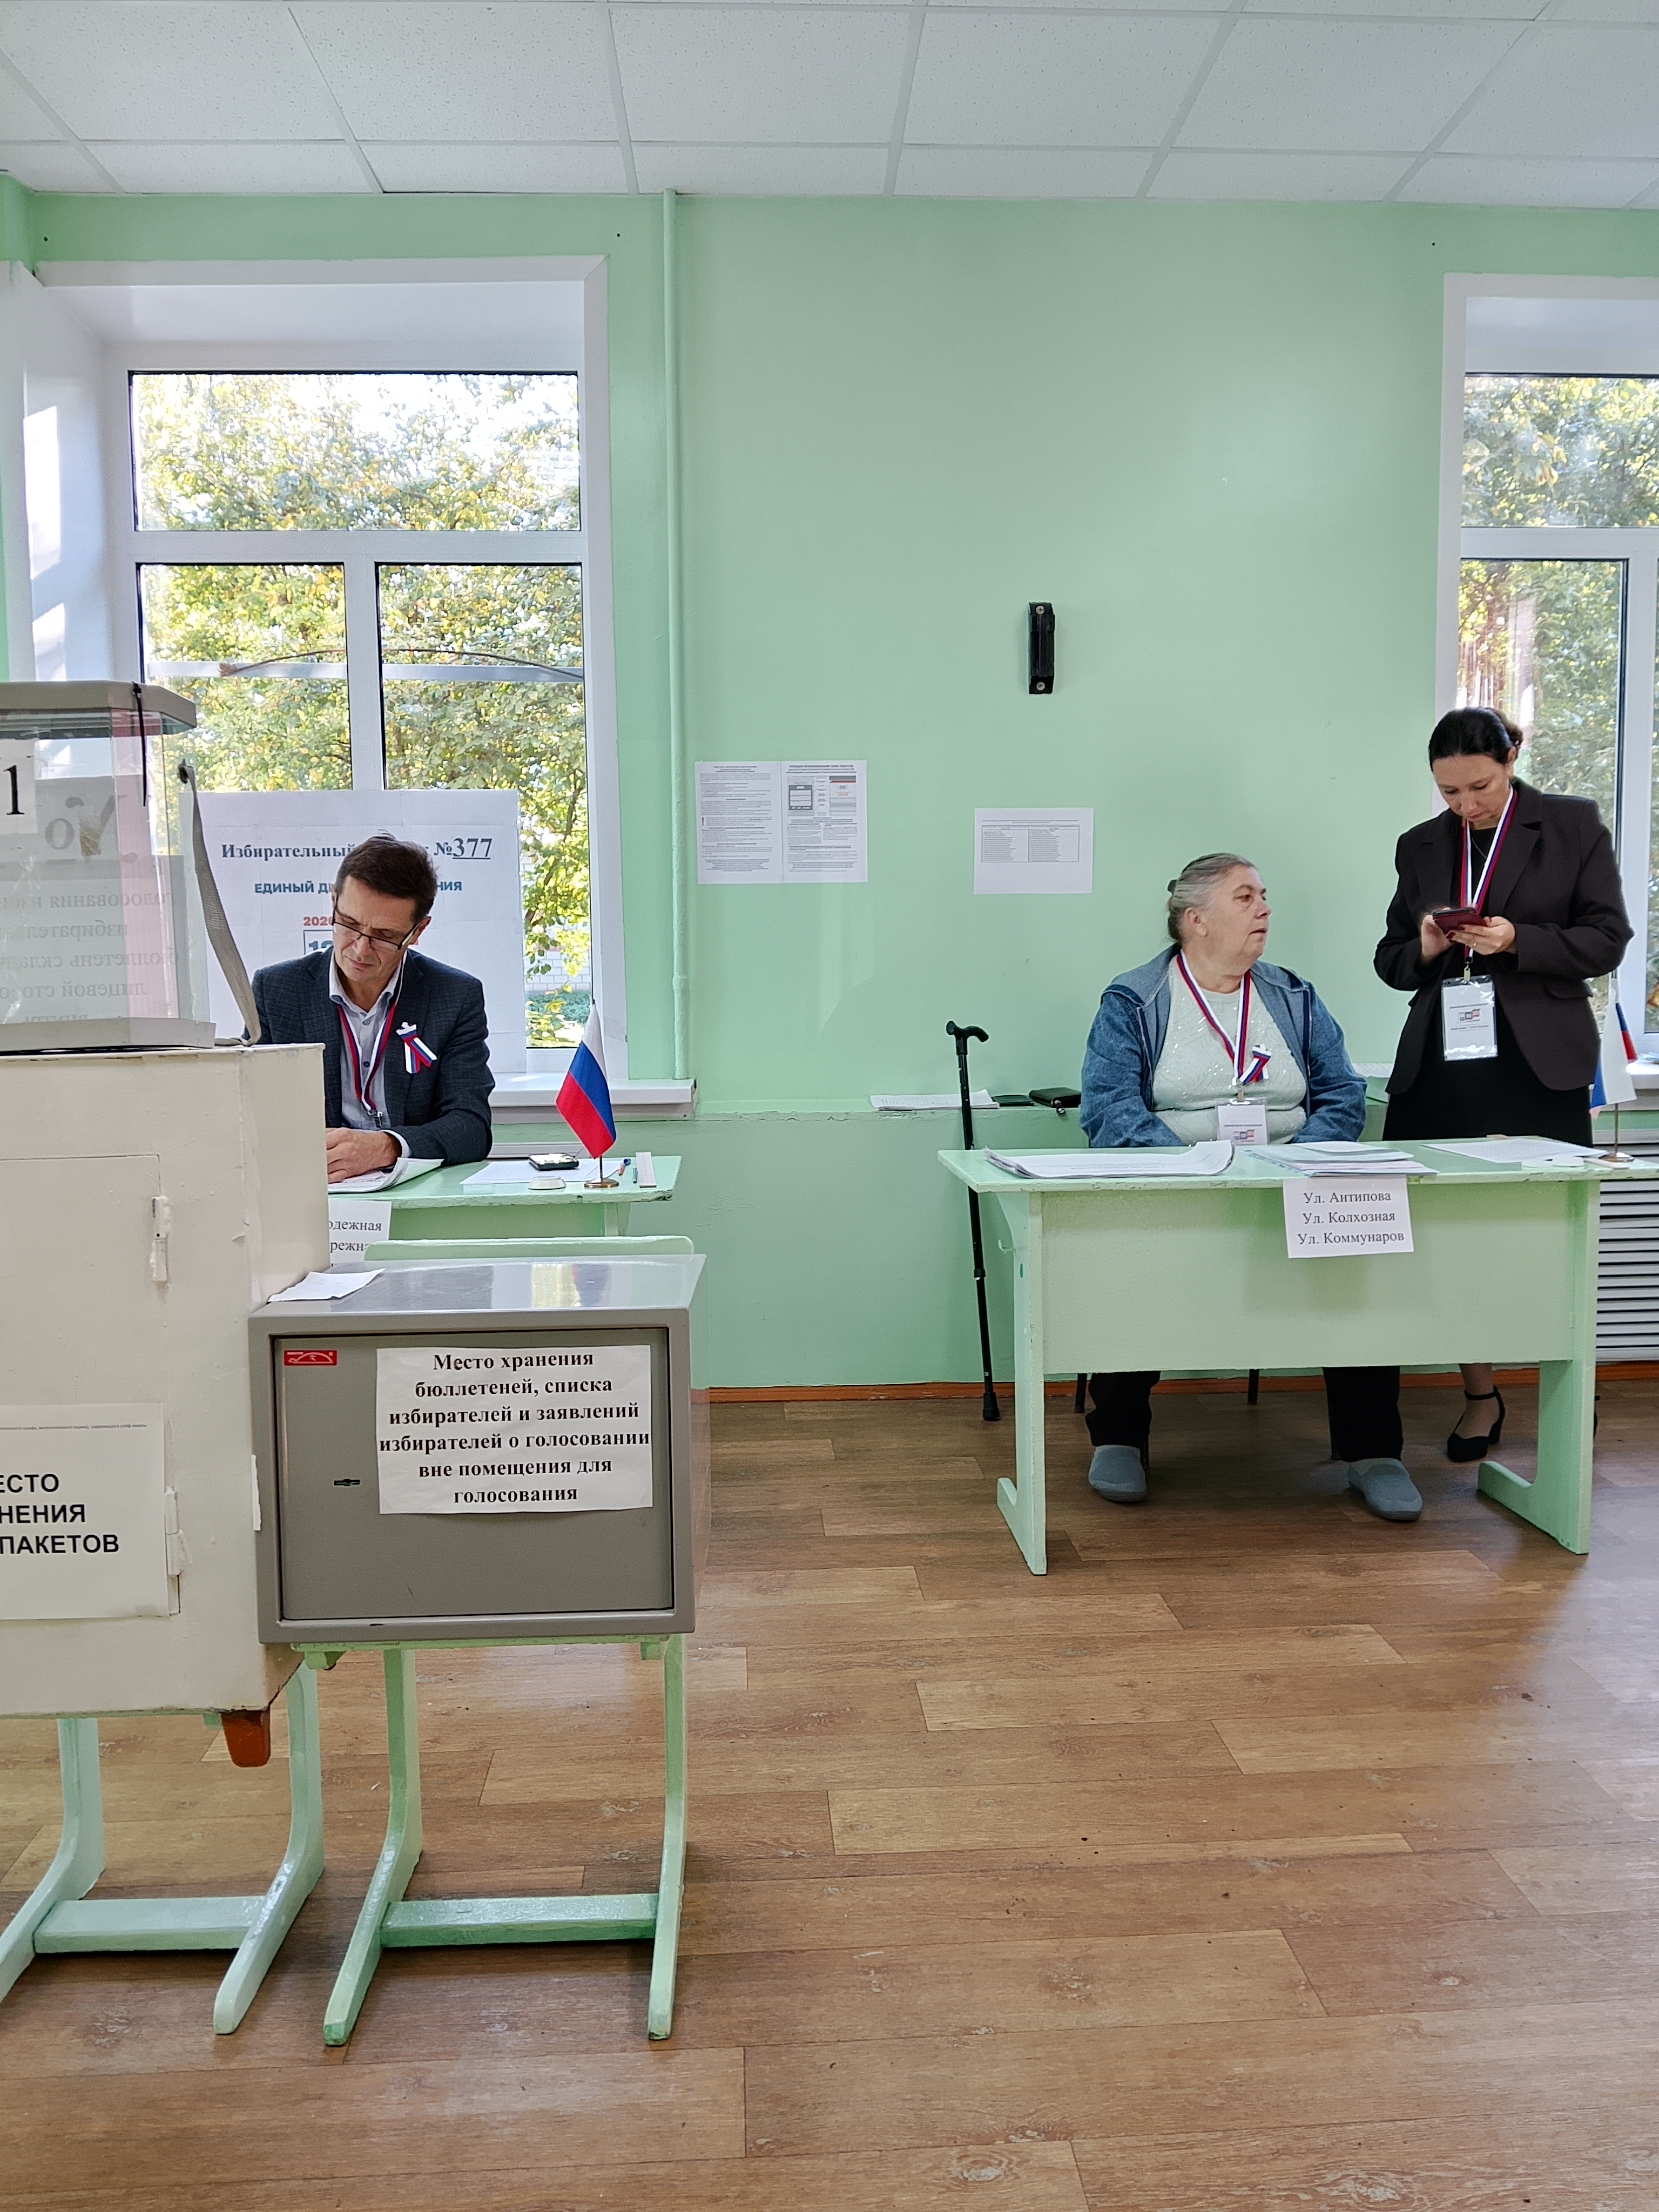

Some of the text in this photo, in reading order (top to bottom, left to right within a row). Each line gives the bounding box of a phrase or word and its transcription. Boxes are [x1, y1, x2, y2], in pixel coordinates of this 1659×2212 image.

[3, 765, 25, 815] 1
[255, 880, 314, 894] ЕДИНЫЙ
[1303, 1192, 1391, 1204] Ул. Антипова
[1303, 1212, 1395, 1224] Ул. Колхозная
[1297, 1232, 1405, 1245] Ул. Коммунаров
[433, 1353, 593, 1372] Место хранения
[415, 1378, 612, 1397] бюллетеней, списка
[389, 1402, 639, 1428] избирателей и заявлений
[380, 1432, 649, 1455] избирателей о голосовании
[419, 1460, 611, 1478] вне помещения для
[455, 1488, 578, 1503] голосования
